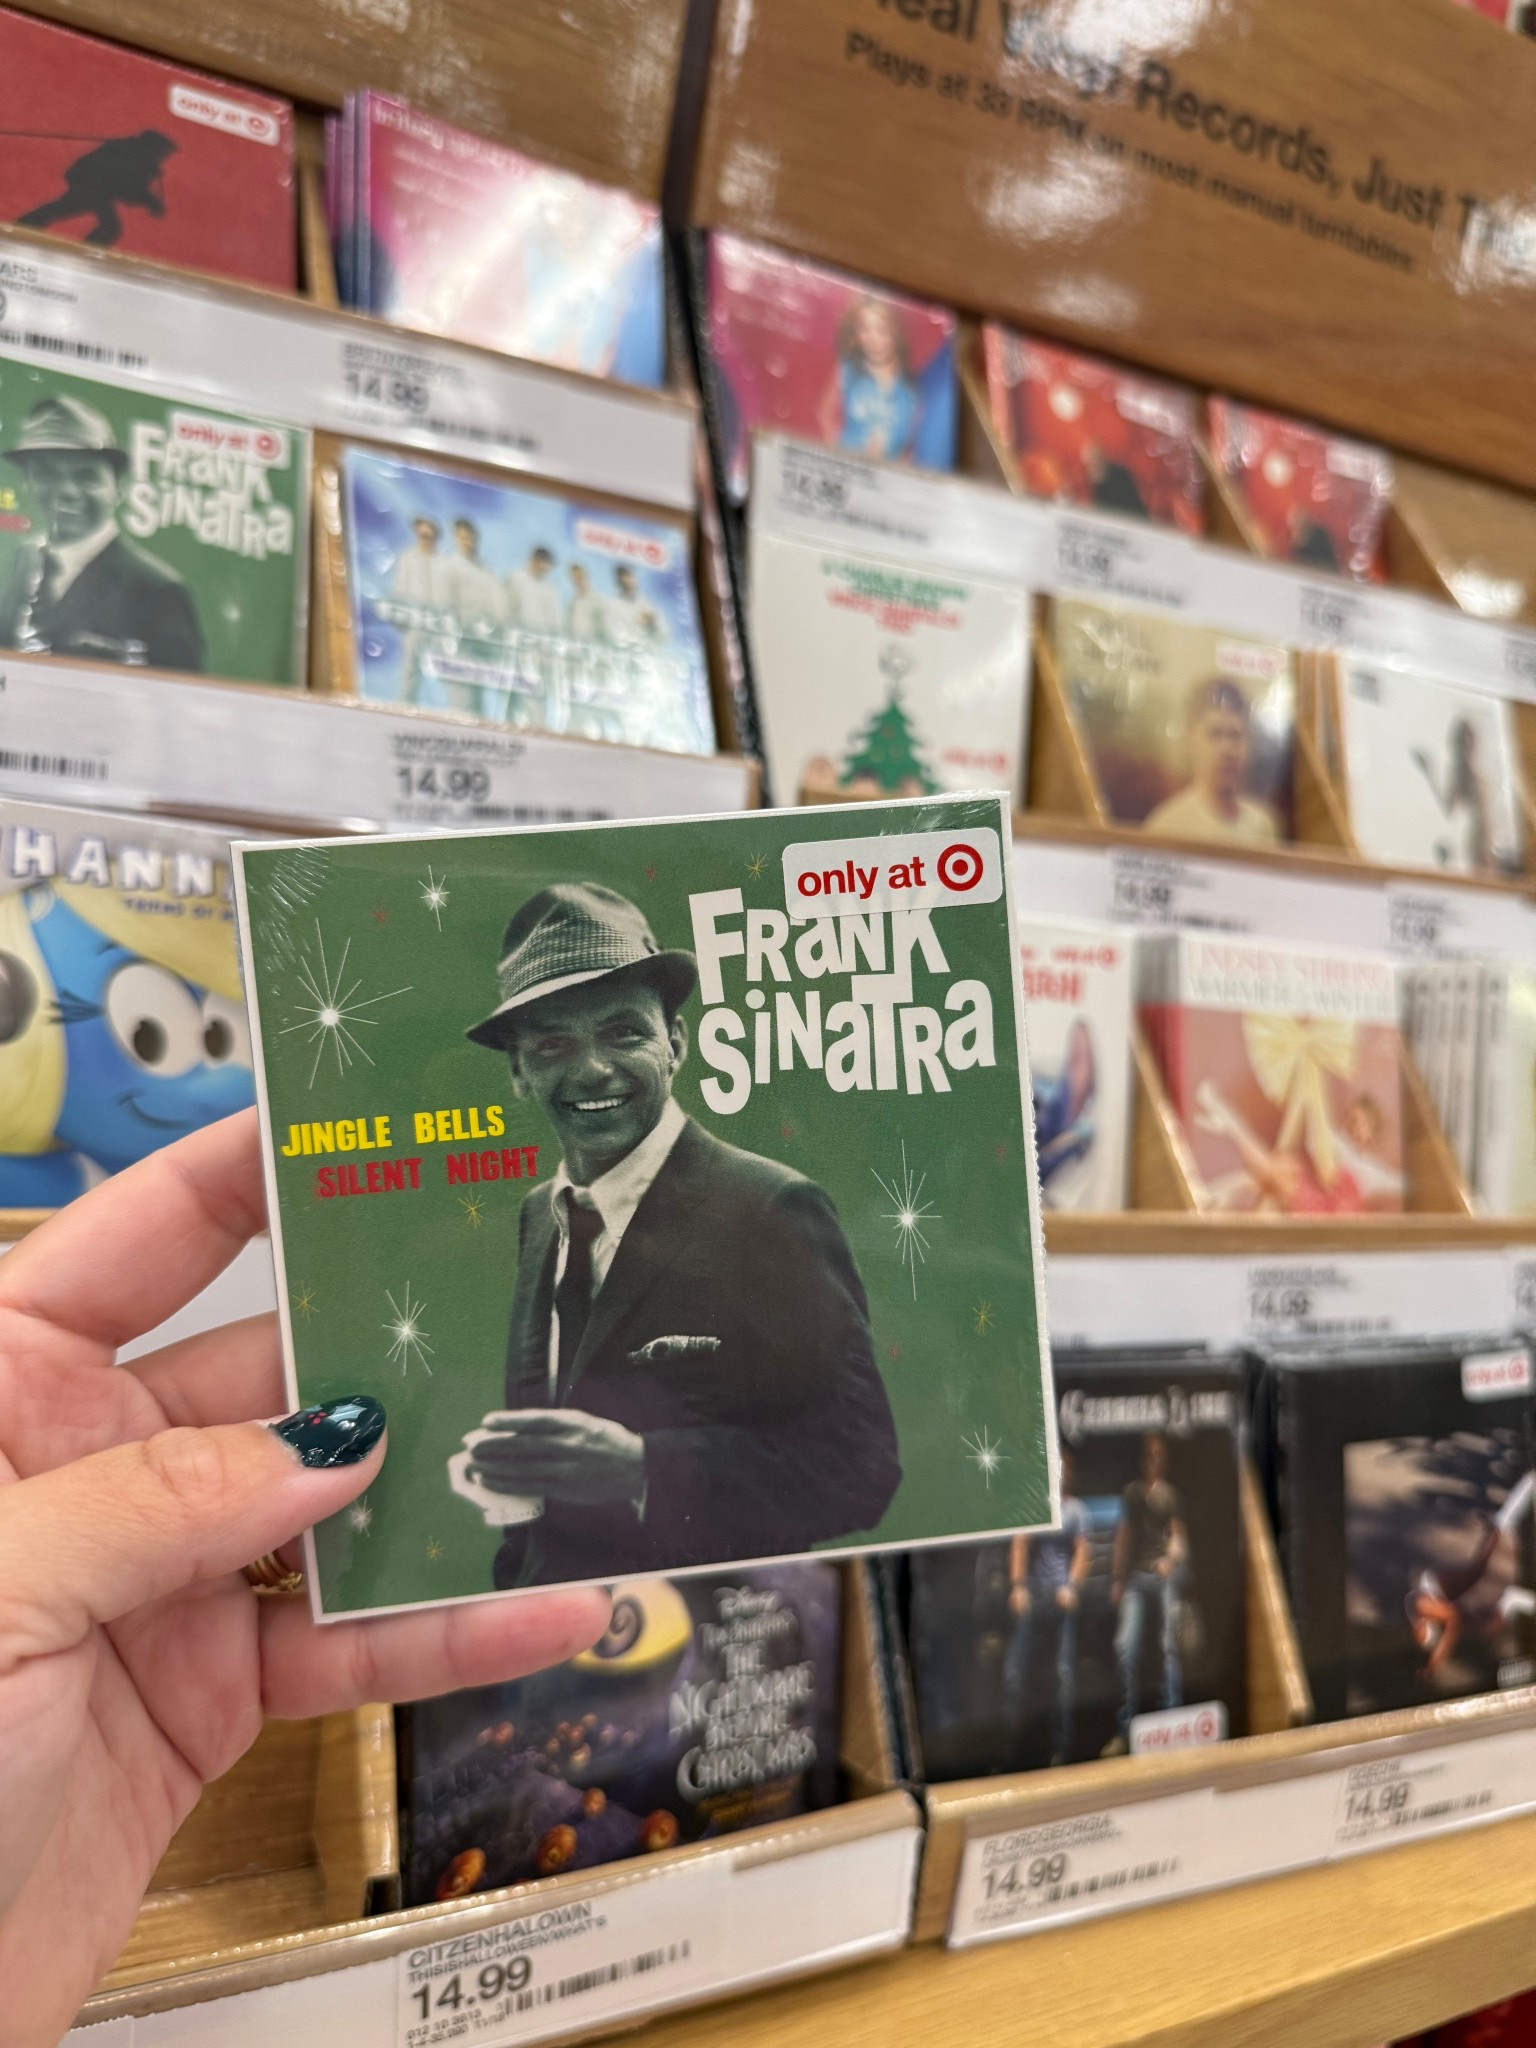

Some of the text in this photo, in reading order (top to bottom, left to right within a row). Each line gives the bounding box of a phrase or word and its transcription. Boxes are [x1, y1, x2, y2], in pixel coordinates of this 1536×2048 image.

[845, 31, 931, 87] Plays
[935, 73, 969, 103] at
[876, 0, 1446, 230] eal Records, Just
[397, 763, 492, 804] 14.99
[10, 822, 233, 900] HANN
[797, 855, 927, 899] only at
[281, 1105, 505, 1158] JINGLE BELLS
[314, 1145, 539, 1198] SILENT NIGHT
[1346, 1780, 1411, 1825] 14.99
[982, 1852, 1069, 1900] 14.99
[408, 1900, 593, 1971] CITZENHALOWN
[411, 1954, 533, 2020] 14.99
